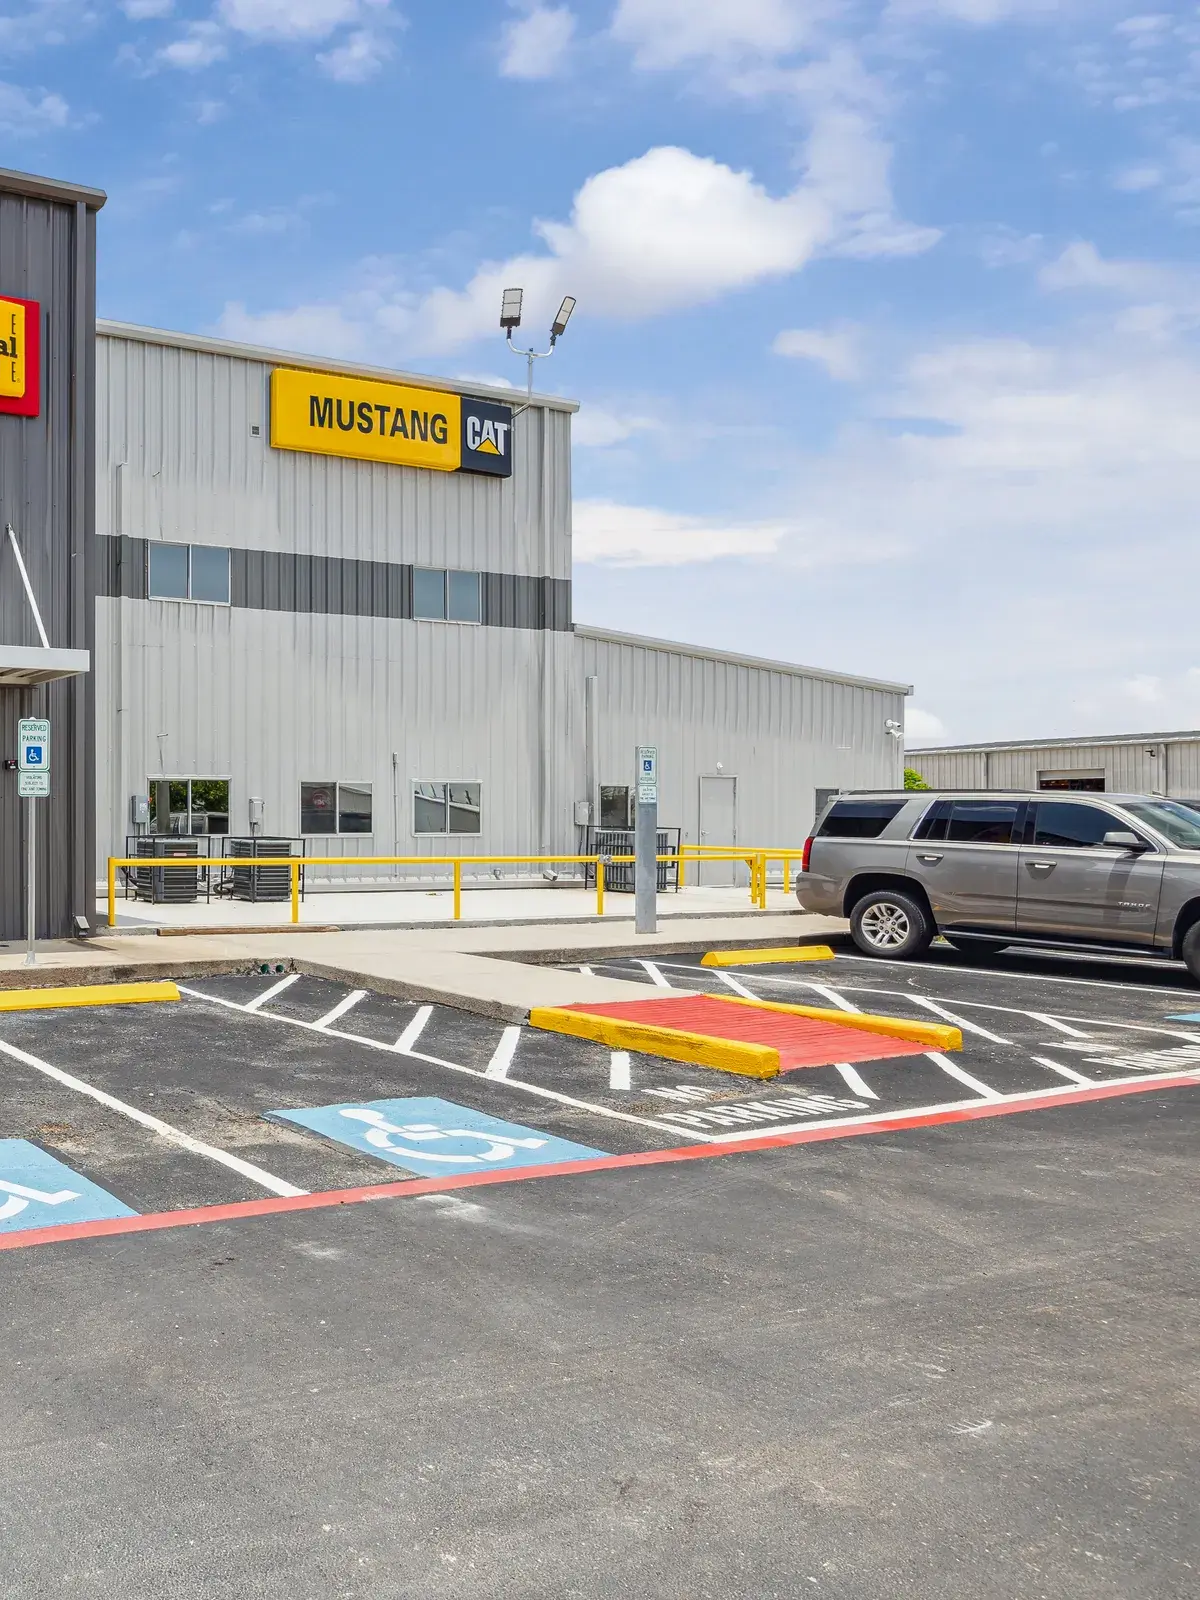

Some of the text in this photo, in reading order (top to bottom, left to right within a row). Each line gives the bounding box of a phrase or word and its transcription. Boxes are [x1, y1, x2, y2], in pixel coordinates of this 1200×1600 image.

[309, 395, 448, 445] MUSTANG
[466, 415, 509, 456] CAT
[21, 724, 47, 732] RESERVED
[655, 1094, 870, 1129] PARKING
